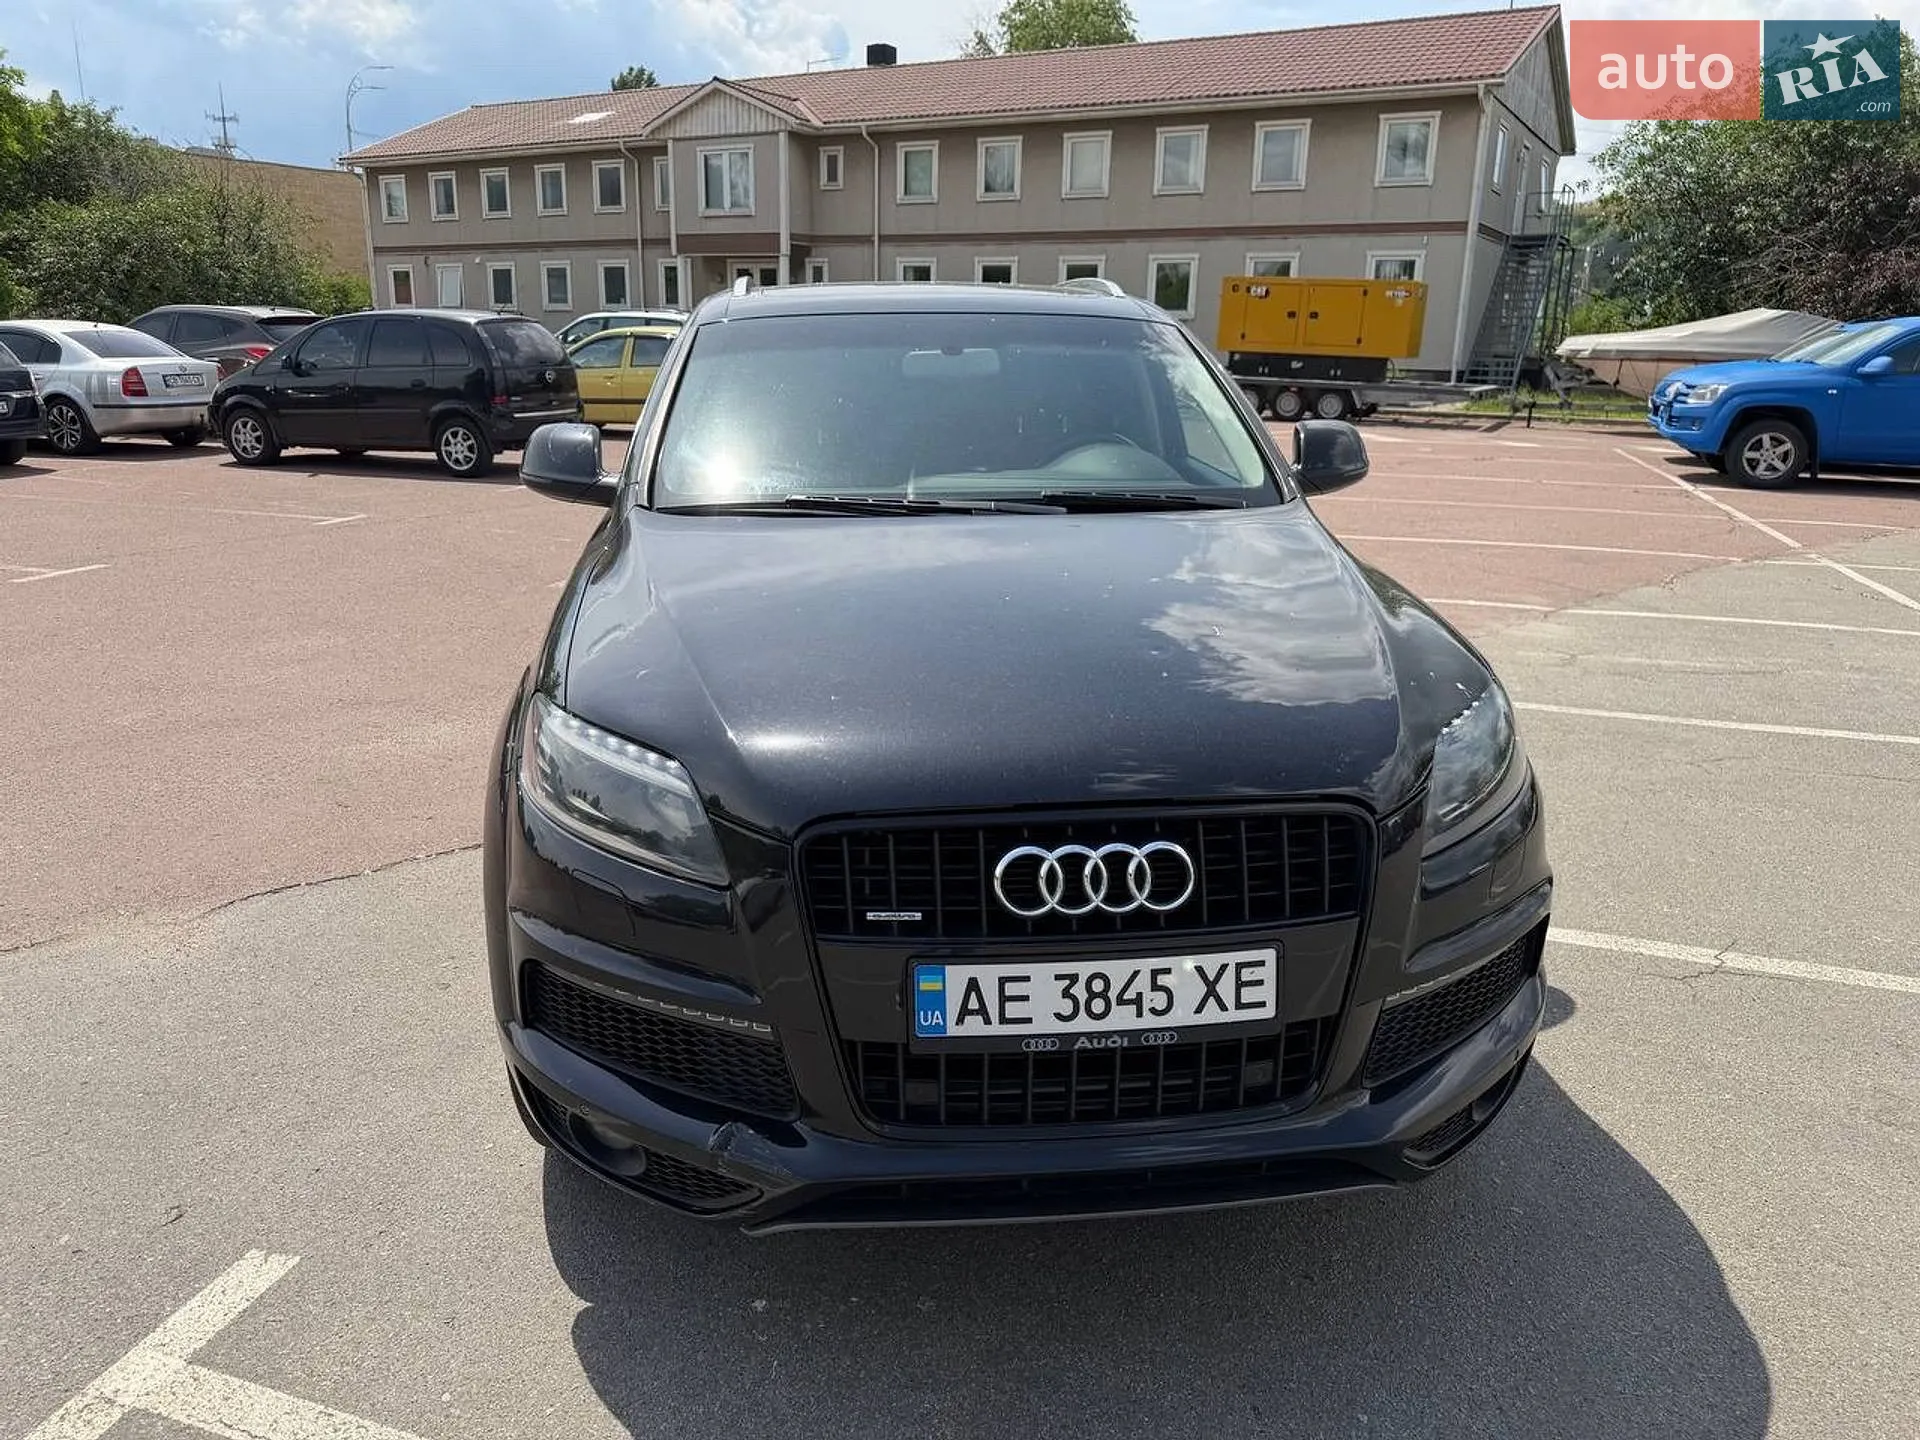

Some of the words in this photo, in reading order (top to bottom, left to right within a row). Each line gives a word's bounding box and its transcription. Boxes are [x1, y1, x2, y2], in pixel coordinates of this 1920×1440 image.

[954, 975, 1033, 1026] AE
[1052, 967, 1175, 1023] 3845
[1193, 959, 1268, 1015] XE
[920, 1010, 944, 1027] UA
[1072, 1035, 1129, 1050] Audi
